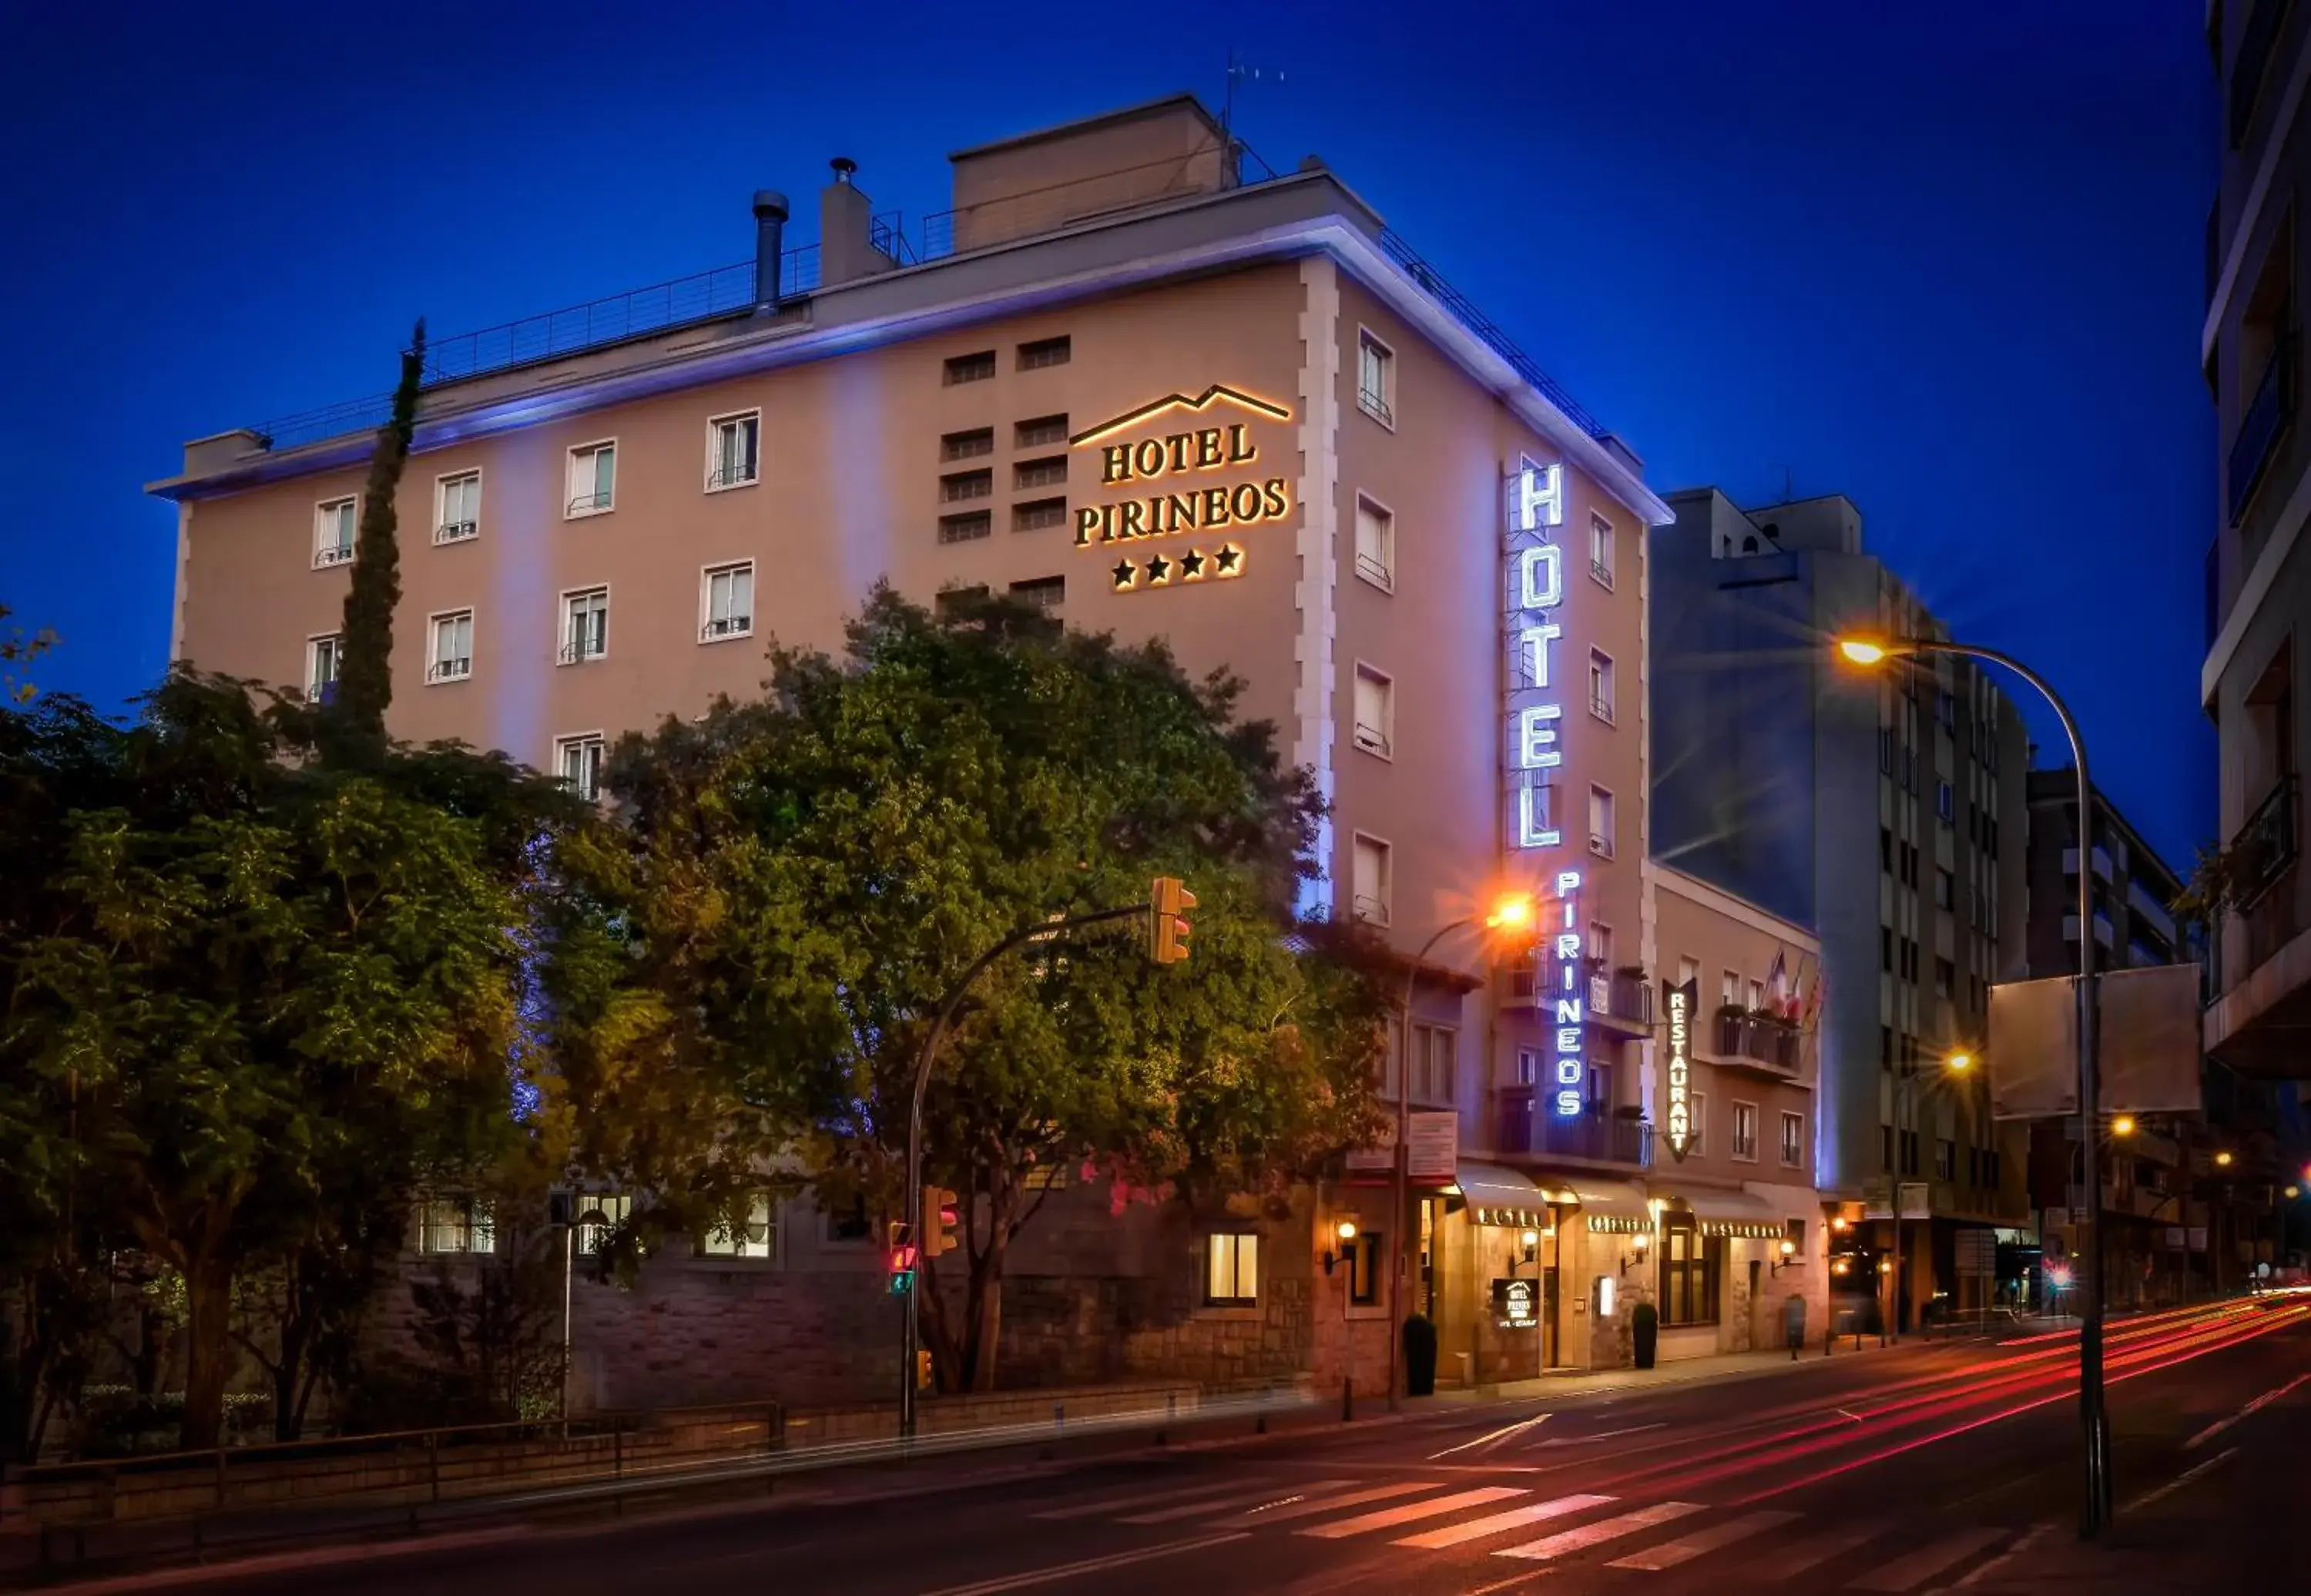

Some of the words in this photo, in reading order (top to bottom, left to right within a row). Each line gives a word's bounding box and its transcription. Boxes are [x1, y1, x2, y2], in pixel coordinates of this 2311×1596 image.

[1101, 423, 1256, 484] HOTEL
[1073, 478, 1287, 546] PIRINEOS
[1519, 463, 1564, 847] HOTEL
[1557, 871, 1581, 1116] PIRINEOS
[1669, 992, 1689, 1152] RESTAURANT
